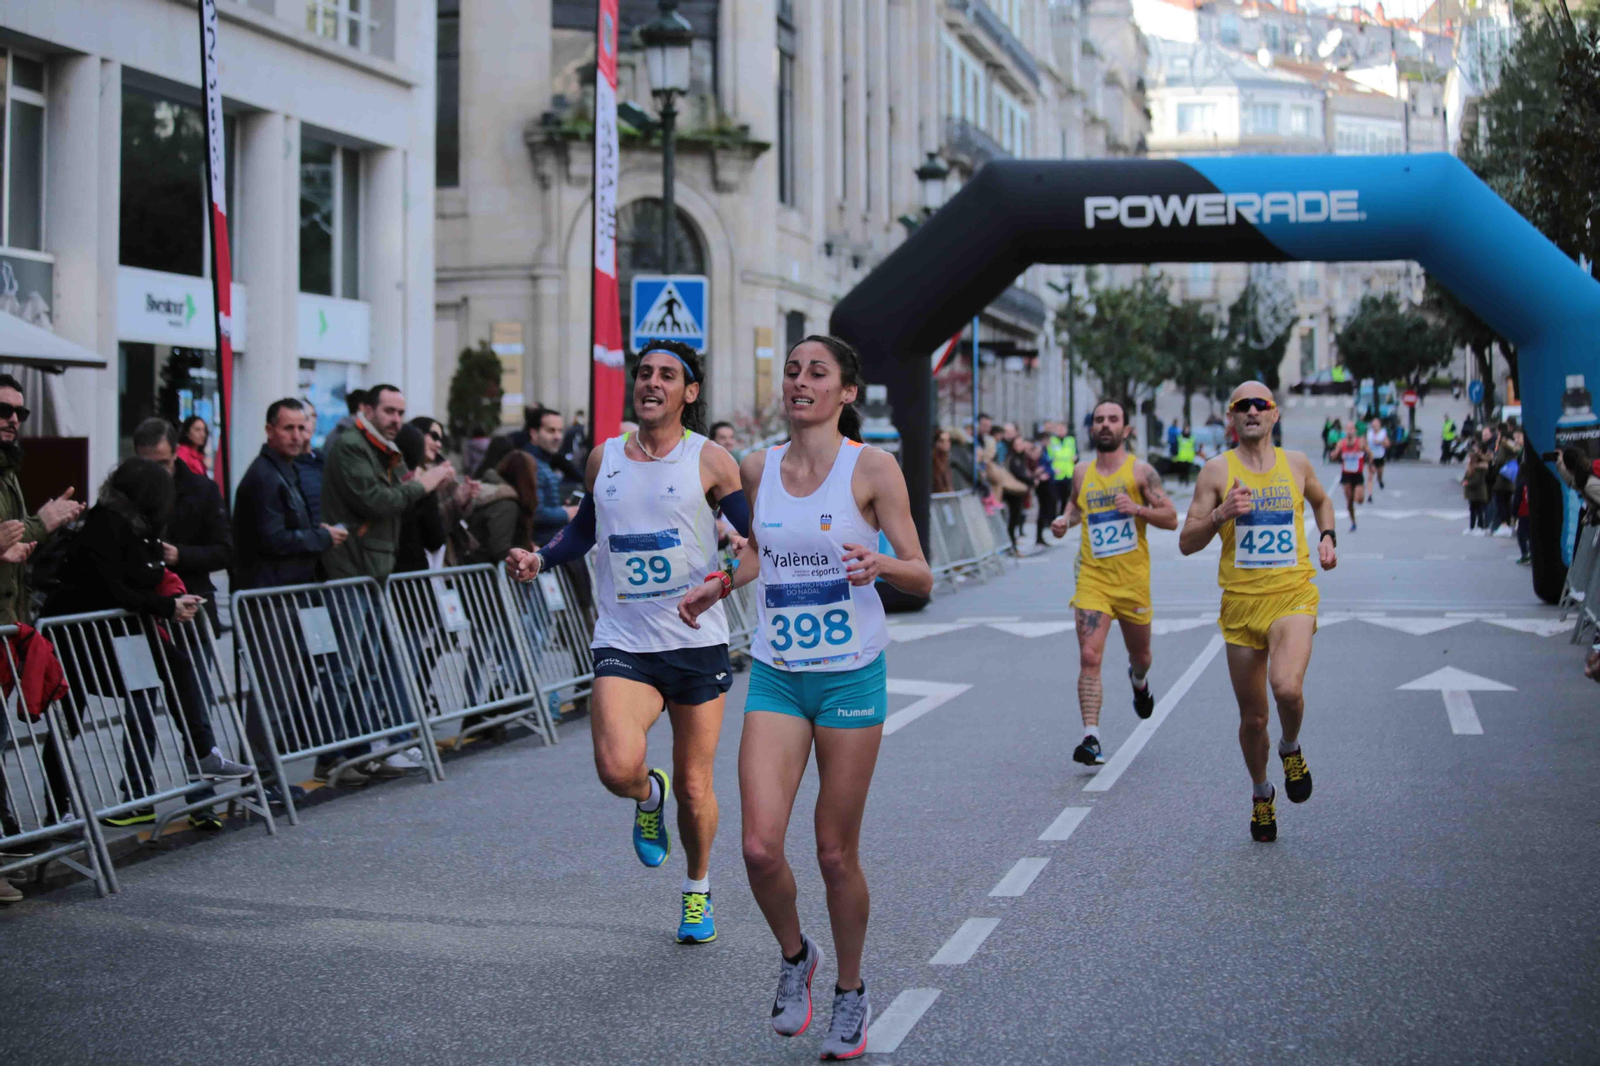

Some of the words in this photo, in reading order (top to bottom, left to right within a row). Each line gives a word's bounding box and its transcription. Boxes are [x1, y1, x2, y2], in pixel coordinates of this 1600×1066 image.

[1084, 189, 1360, 229] POWERADE
[1092, 521, 1134, 547] 324
[1240, 529, 1294, 554] 428
[625, 555, 672, 586] 39
[771, 552, 829, 568] València
[811, 567, 840, 578] esports
[789, 581, 815, 589] PREMIO
[770, 608, 853, 652] 398
[837, 705, 875, 717] hummel
